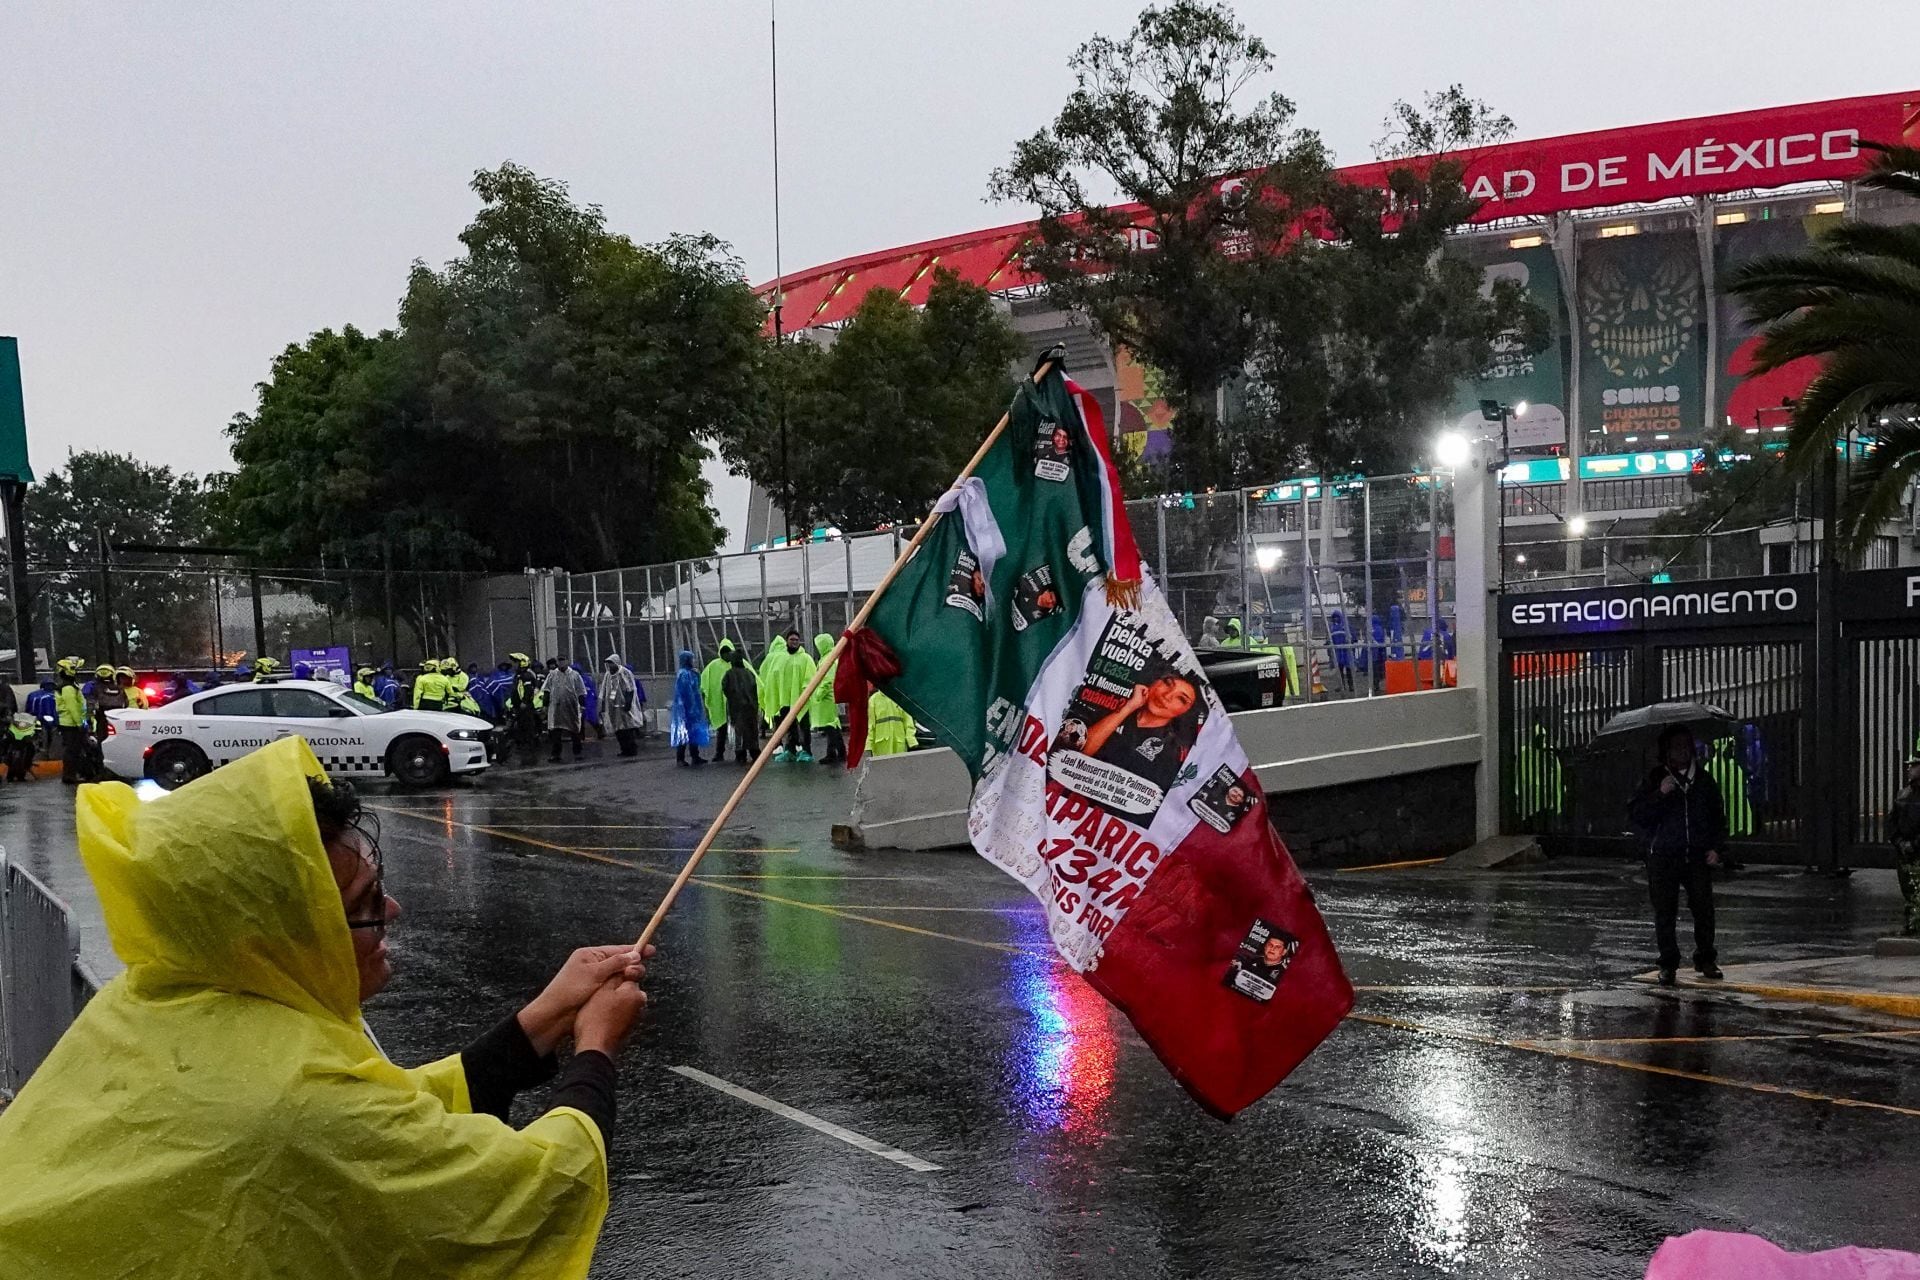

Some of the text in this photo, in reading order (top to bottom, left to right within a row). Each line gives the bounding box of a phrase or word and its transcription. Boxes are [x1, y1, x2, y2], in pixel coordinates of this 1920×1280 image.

[1561, 156, 1628, 193] DE
[1648, 129, 1859, 182] MÉXICO
[1602, 385, 1681, 406] SOMOS
[1603, 405, 1681, 420] CIUDAD DE
[1511, 587, 1798, 624] ESTACIONAMIENTO
[1105, 623, 1153, 658] pelota
[1100, 641, 1146, 672] vuelve
[1099, 676, 1133, 698] Monserrat
[151, 725, 183, 735] 24903
[213, 739, 271, 748] GUARDIA
[1060, 753, 1077, 767] Jael
[1076, 759, 1110, 779] Monserrat
[1109, 769, 1126, 785] Uribe
[1061, 767, 1151, 807] desapareció el 24 de julio de 2020
